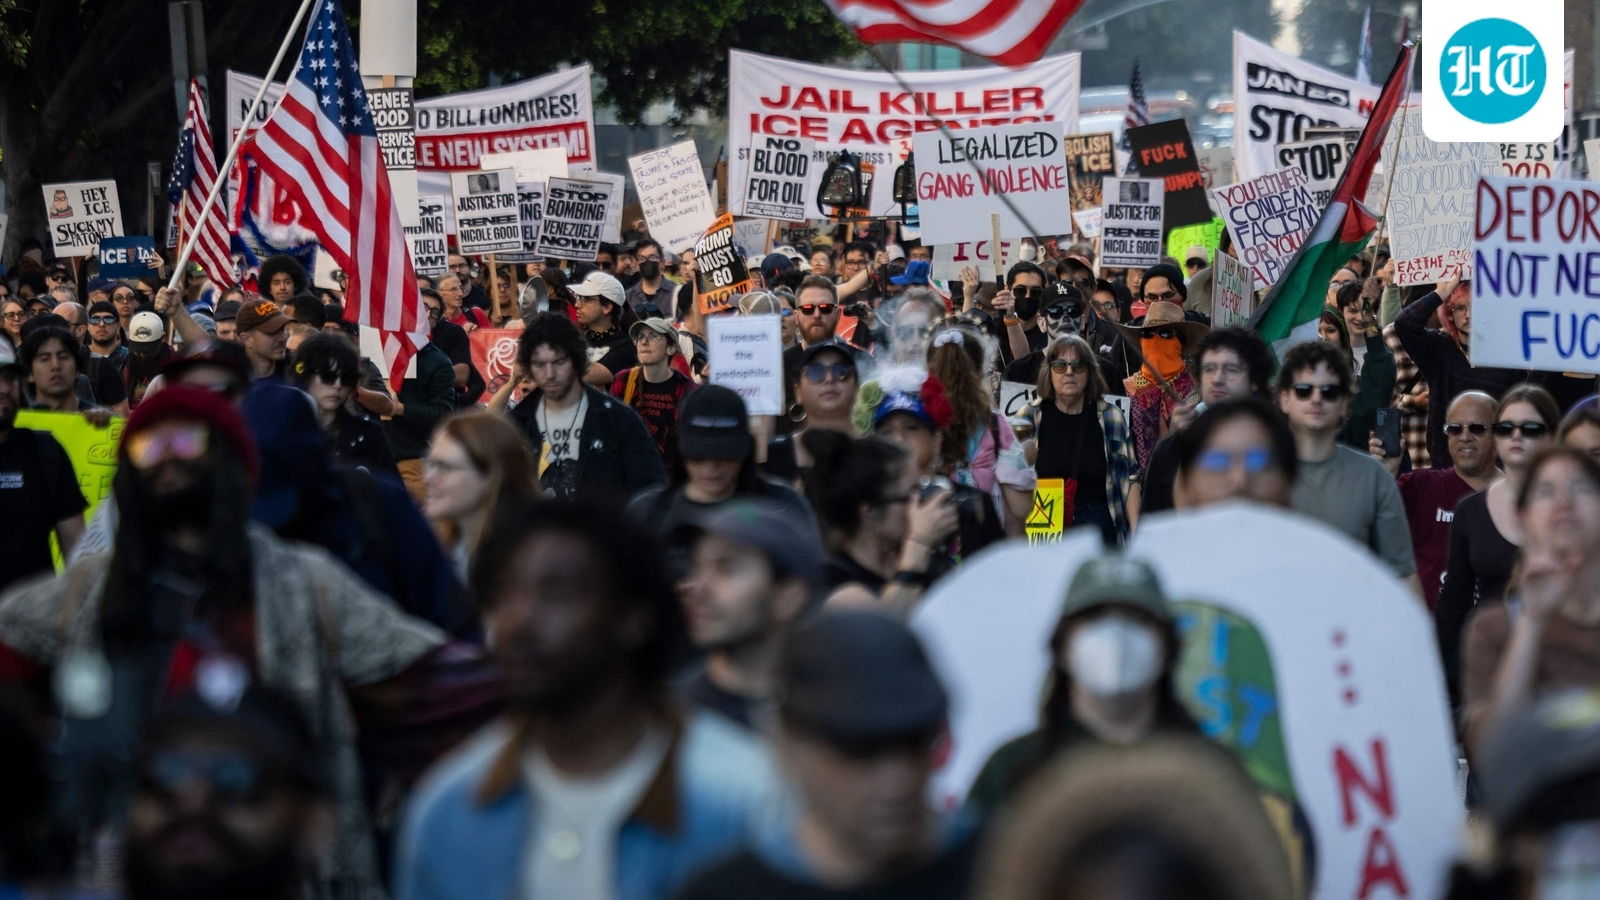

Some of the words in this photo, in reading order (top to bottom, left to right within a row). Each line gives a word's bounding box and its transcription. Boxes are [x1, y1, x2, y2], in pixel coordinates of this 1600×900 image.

[1248, 67, 1306, 97] JAN
[1307, 85, 1349, 107] 20
[366, 91, 410, 110] RENEE
[760, 86, 870, 113] JAIL
[880, 86, 1045, 115] KILLER
[436, 93, 579, 129] BILLIONAIRES!
[750, 113, 829, 142] ICE
[377, 131, 416, 147] SERVES
[766, 137, 801, 151] NO
[938, 131, 1059, 164] LEGALIZED
[1065, 135, 1111, 156] BOLISH
[438, 139, 490, 167] NEW
[641, 148, 672, 164] STOP
[1140, 142, 1188, 166] FUCK
[1278, 142, 1342, 181] STOP
[1524, 143, 1548, 161] IS
[753, 149, 809, 178] BLOOD
[1081, 153, 1112, 173] ICE
[638, 177, 668, 193] POLICE
[748, 178, 780, 203] FOR
[781, 181, 805, 206] OIL
[917, 171, 975, 201] GANG
[976, 164, 1067, 196] VIOLENCE
[1164, 171, 1204, 193] UMP!
[1217, 181, 1256, 208] YOU
[1252, 166, 1309, 198] EITHER
[80, 187, 107, 203] HEY
[457, 195, 496, 212] JUSTICE
[496, 193, 517, 209] FOR
[549, 188, 609, 203] STOP
[642, 192, 669, 207] TRUMP
[84, 201, 115, 217] ICE.
[545, 198, 605, 222] BOMBING
[645, 207, 658, 218] BY
[1104, 204, 1143, 221] JUSTICE
[1143, 205, 1161, 222] FOR
[1229, 185, 1314, 226] CONDEM
[1390, 194, 1476, 230] BLAME
[459, 214, 518, 228] RENEE
[543, 219, 600, 239] VENEZUELA
[1233, 203, 1322, 250] FACISM
[56, 221, 96, 242] SUCK
[460, 227, 493, 243] NICOLE
[493, 225, 520, 240] GOOD
[1104, 227, 1160, 238] RENEE
[414, 238, 446, 255] ZUELA
[540, 235, 599, 251] NOW!
[695, 227, 732, 257] TRUMP
[1103, 239, 1135, 254] NICOLE
[1136, 240, 1160, 255] GOOD
[1243, 242, 1273, 267] OR
[1268, 230, 1304, 257] YOU
[101, 248, 127, 265] ICE
[698, 246, 735, 274] MUST
[713, 266, 733, 287] GO
[1473, 247, 1551, 299] NOT
[1056, 283, 1068, 295] LA
[720, 331, 770, 345] Impeach
[734, 349, 754, 361] the
[734, 386, 762, 398] OW!
